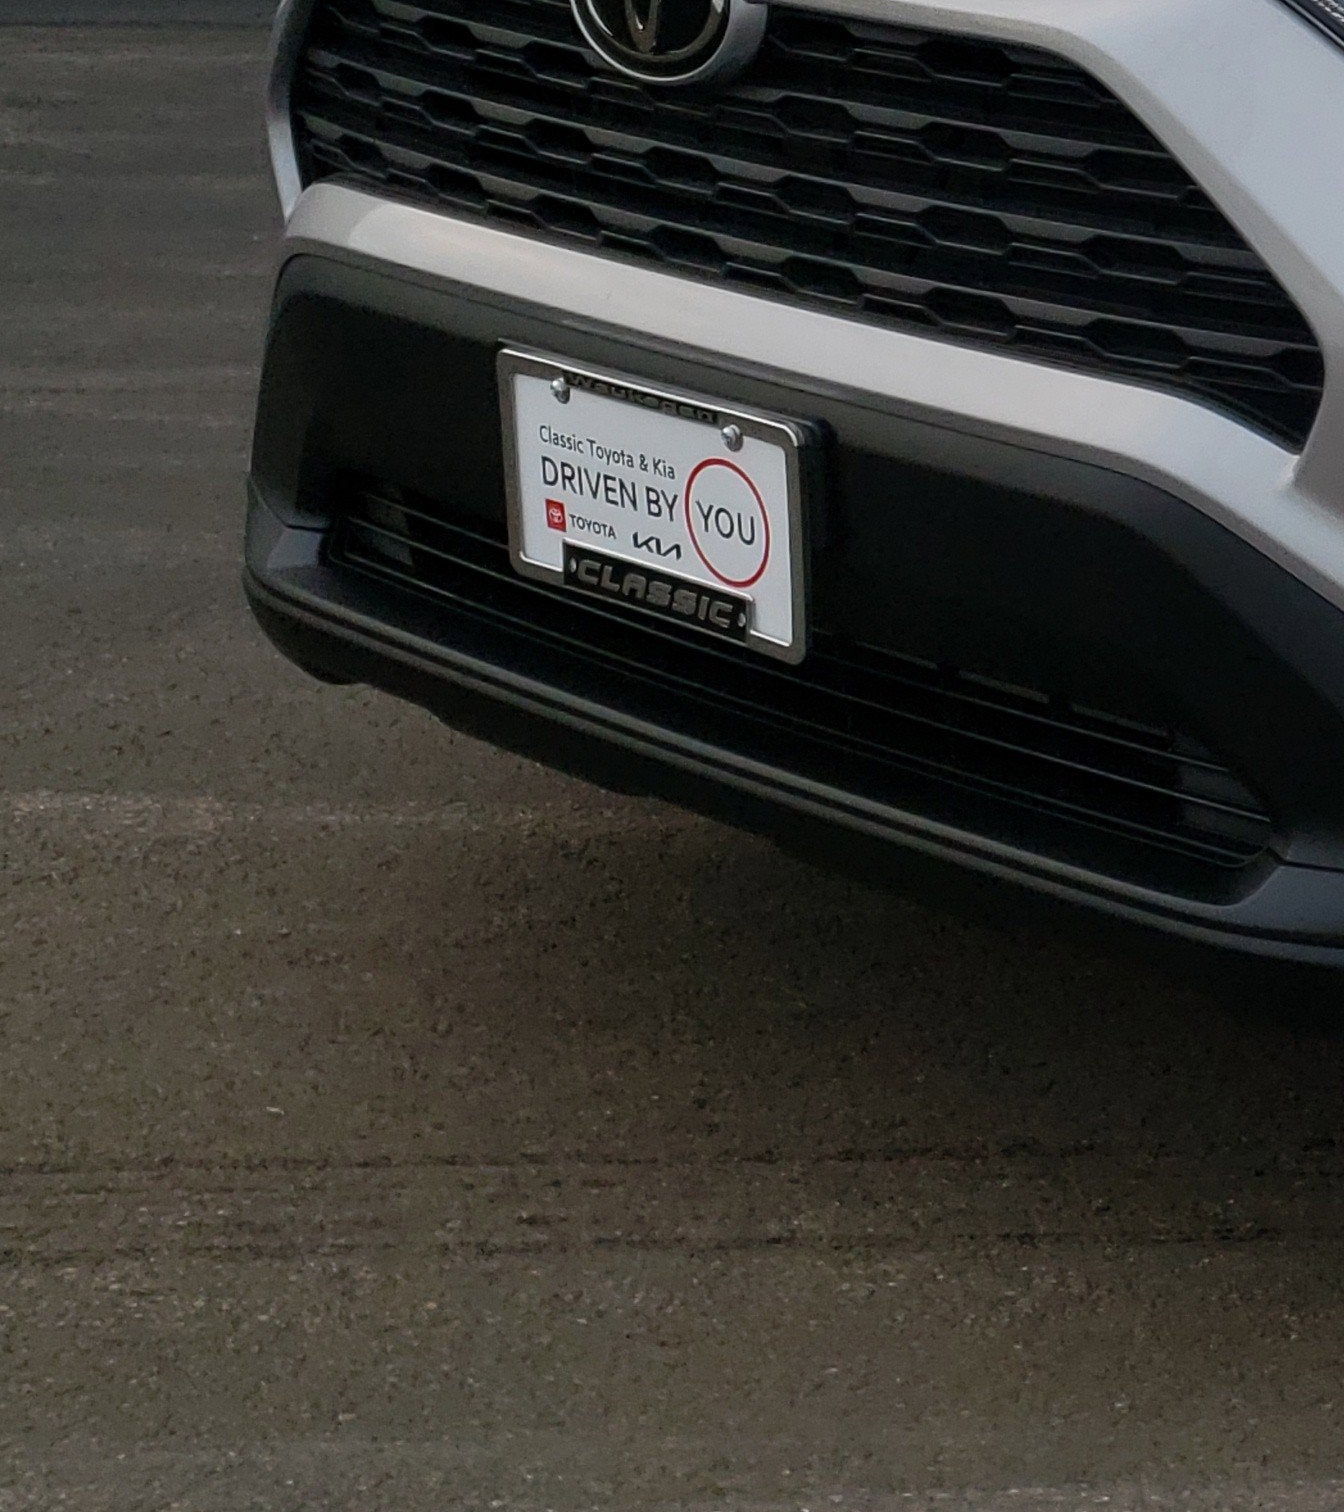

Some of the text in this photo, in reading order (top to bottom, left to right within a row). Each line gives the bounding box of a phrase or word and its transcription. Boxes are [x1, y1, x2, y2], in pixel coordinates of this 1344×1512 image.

[539, 424, 676, 480] Classic Toyota & Kia
[541, 455, 756, 546] DRIVEN BY YOU
[568, 513, 617, 540] TOYOTA
[577, 559, 734, 629] CLASSIC
